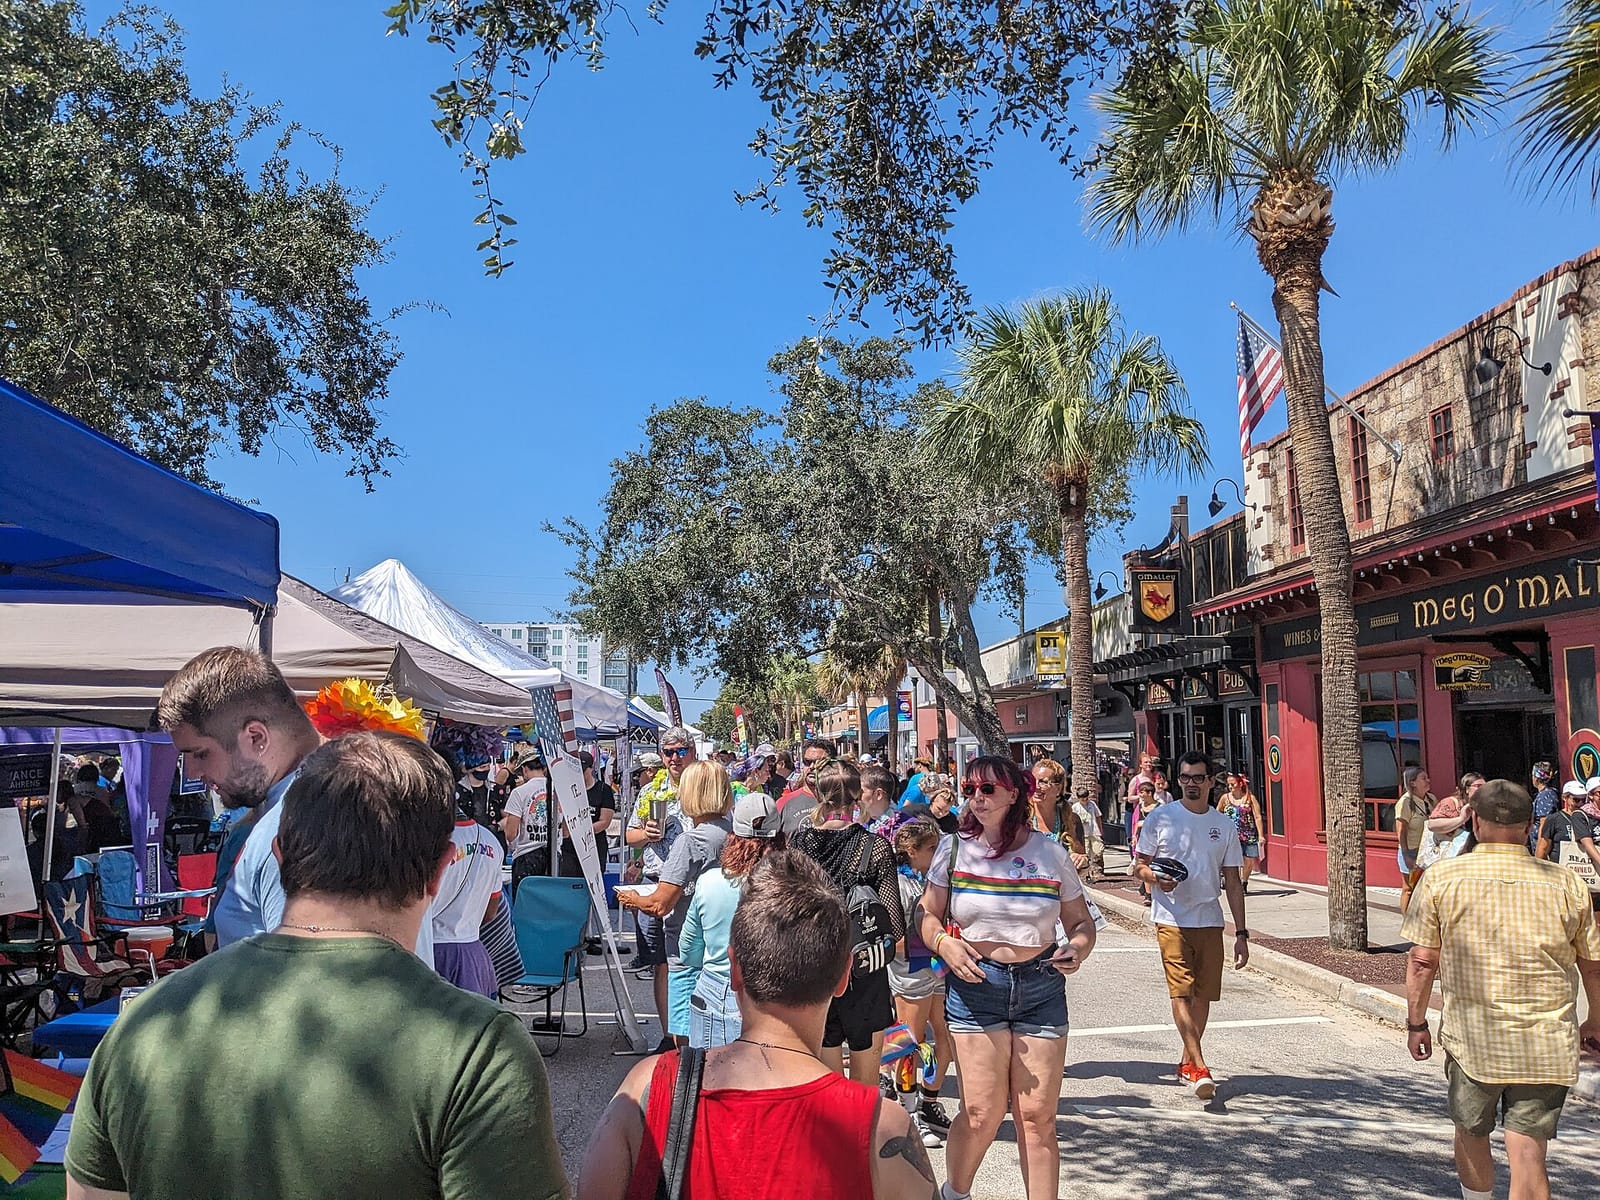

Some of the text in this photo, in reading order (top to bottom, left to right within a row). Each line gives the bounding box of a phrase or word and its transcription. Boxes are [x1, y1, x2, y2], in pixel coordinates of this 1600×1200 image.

[1283, 629, 1312, 647] WINES
[1223, 673, 1245, 689] PUB
[861, 925, 878, 935] adidas
